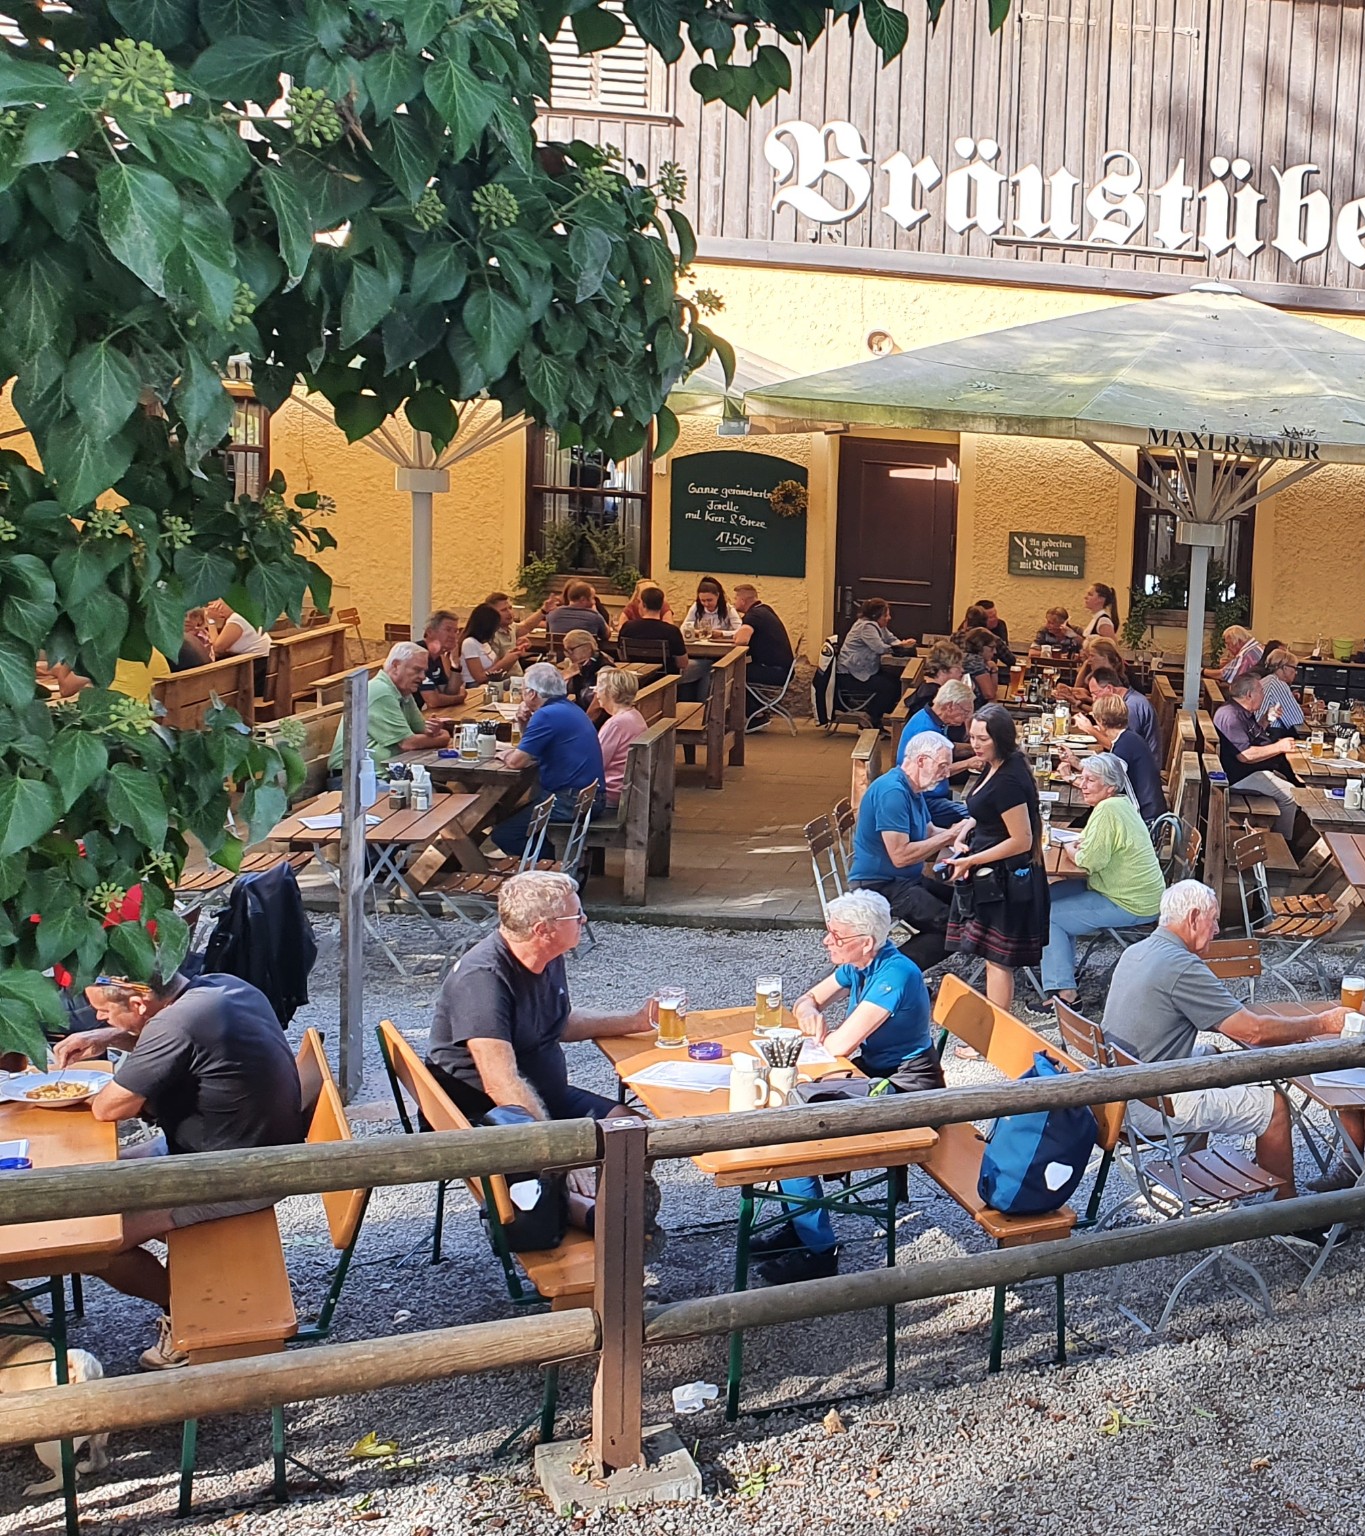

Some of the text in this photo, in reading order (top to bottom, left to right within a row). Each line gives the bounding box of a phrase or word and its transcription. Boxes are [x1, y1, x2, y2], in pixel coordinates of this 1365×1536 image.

[1147, 427, 1320, 460] MAXLRAINER
[687, 482, 719, 494] Ganze
[685, 510, 702, 520] mit
[1029, 537, 1040, 546] An
[1019, 559, 1079, 575] mit Bedienung
